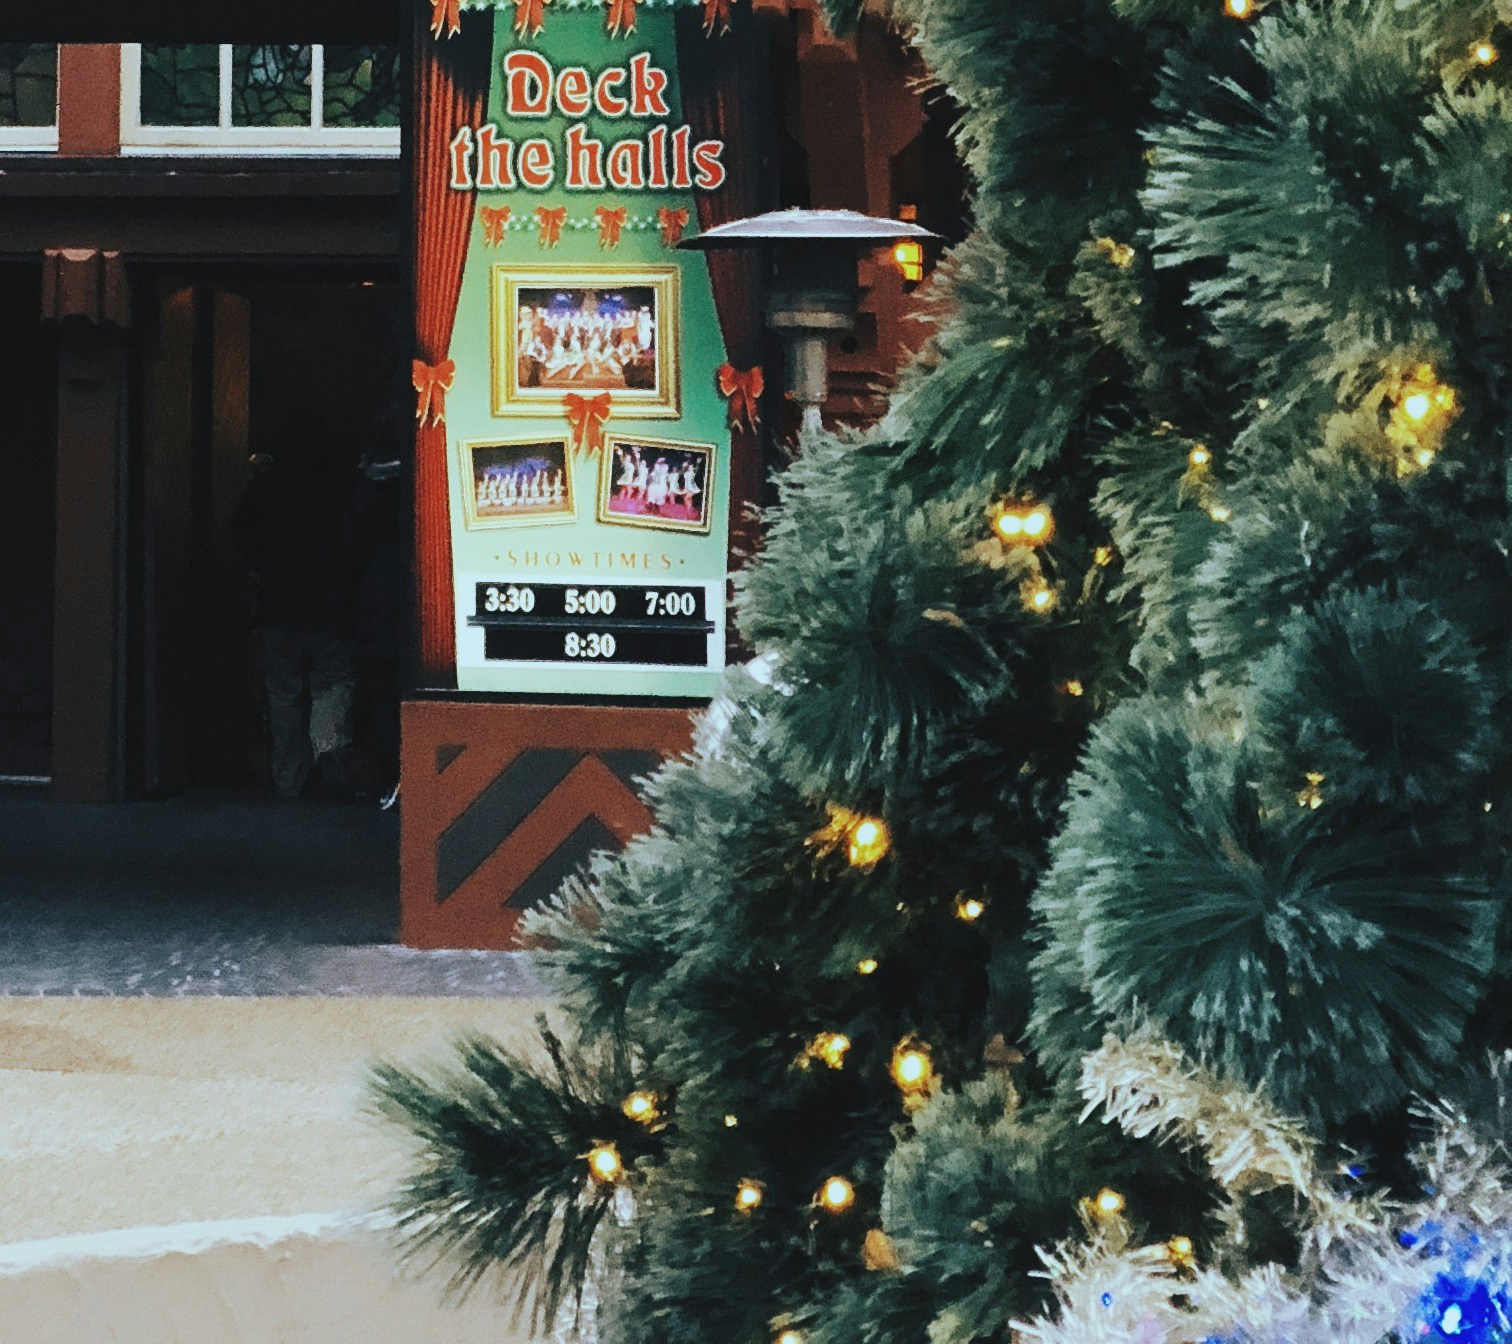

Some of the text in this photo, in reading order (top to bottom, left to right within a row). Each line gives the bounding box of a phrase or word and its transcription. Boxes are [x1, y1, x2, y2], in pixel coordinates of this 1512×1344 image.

[504, 50, 670, 116] Deck
[450, 124, 726, 189] the halls
[505, 550, 674, 570] SHOWTIMES
[485, 587, 696, 616] 3:30 5:00 7:00
[565, 632, 617, 658] 8:30
